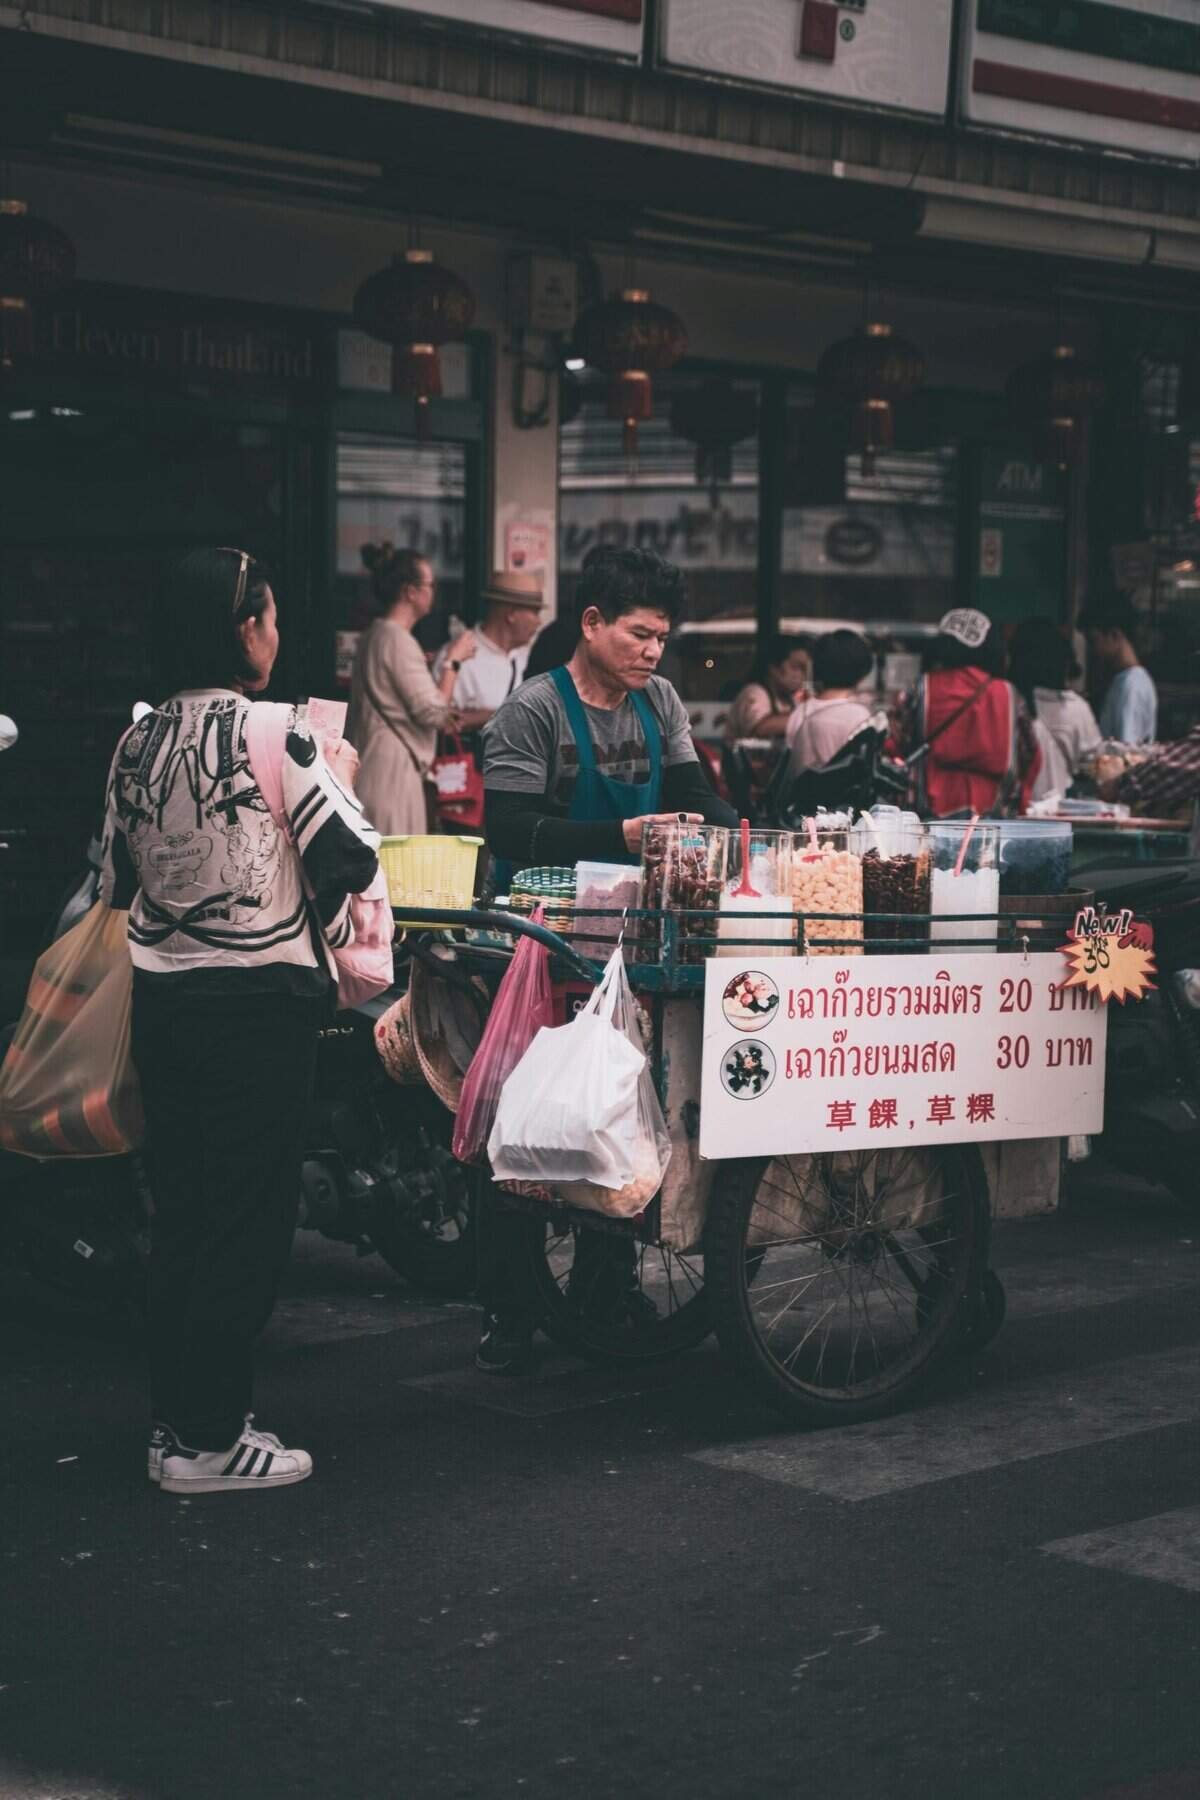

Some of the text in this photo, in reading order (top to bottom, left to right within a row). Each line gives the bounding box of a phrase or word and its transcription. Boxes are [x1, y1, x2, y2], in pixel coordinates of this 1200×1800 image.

[996, 461, 1042, 489] ATM
[1075, 907, 1132, 937] New!
[1084, 947, 1110, 974] 30
[787, 970, 982, 1019] เฉาก๊วยรวมมิตร
[999, 978, 1032, 1013] 20
[785, 1029, 1093, 1079] เฉาก๊วยนมสด 30 บาท
